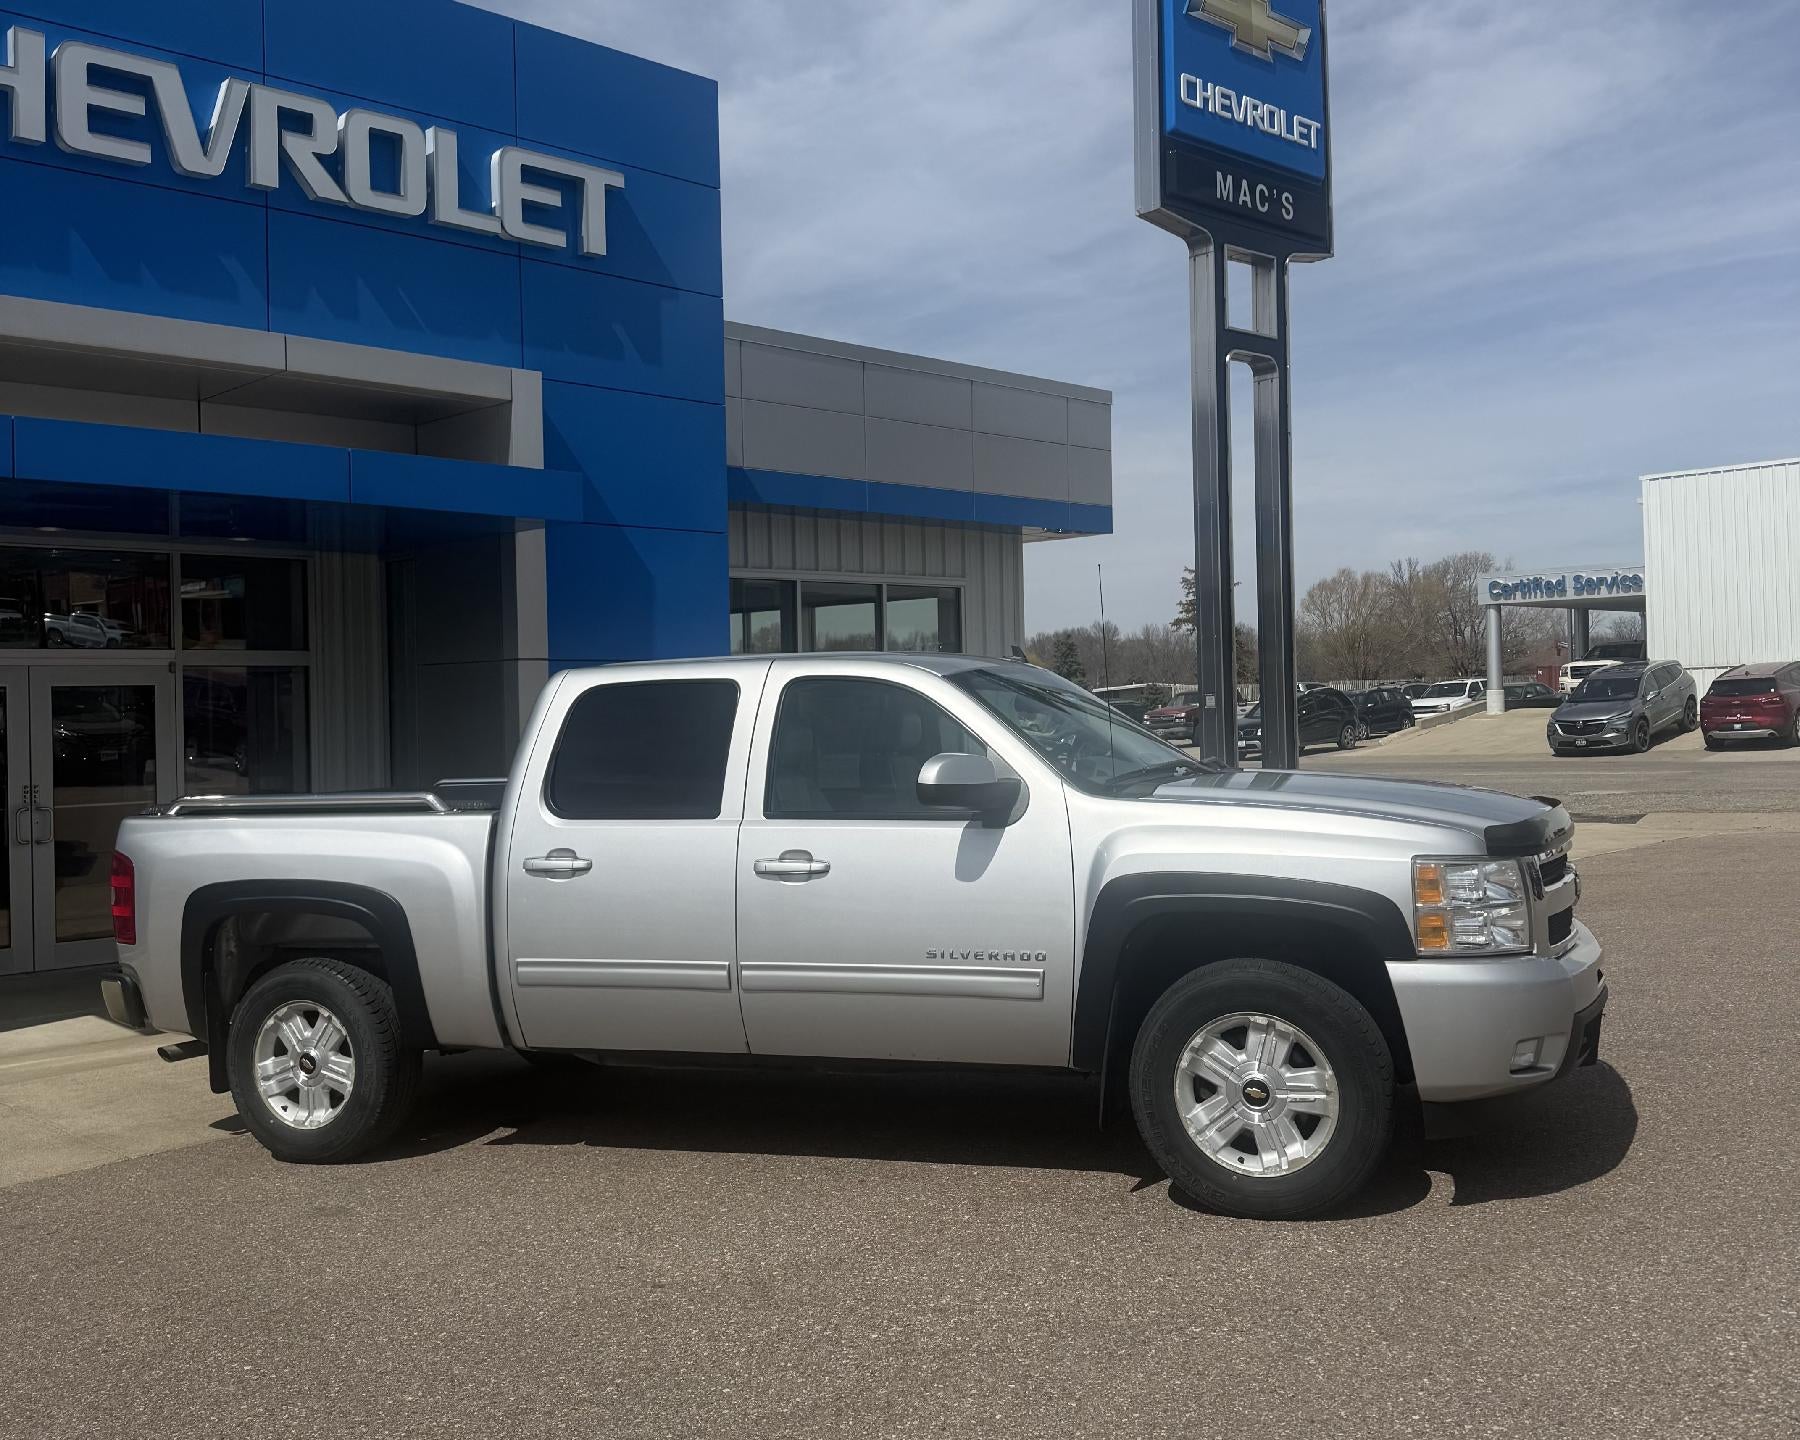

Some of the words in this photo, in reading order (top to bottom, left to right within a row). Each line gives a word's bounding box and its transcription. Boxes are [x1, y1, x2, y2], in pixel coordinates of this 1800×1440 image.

[1180, 73, 1321, 149] CHEVROLET
[1216, 170, 1294, 221] MAC'S
[1488, 575, 1567, 598] Certified
[1572, 571, 1643, 595] Service
[926, 948, 1047, 962] SILVERADO
